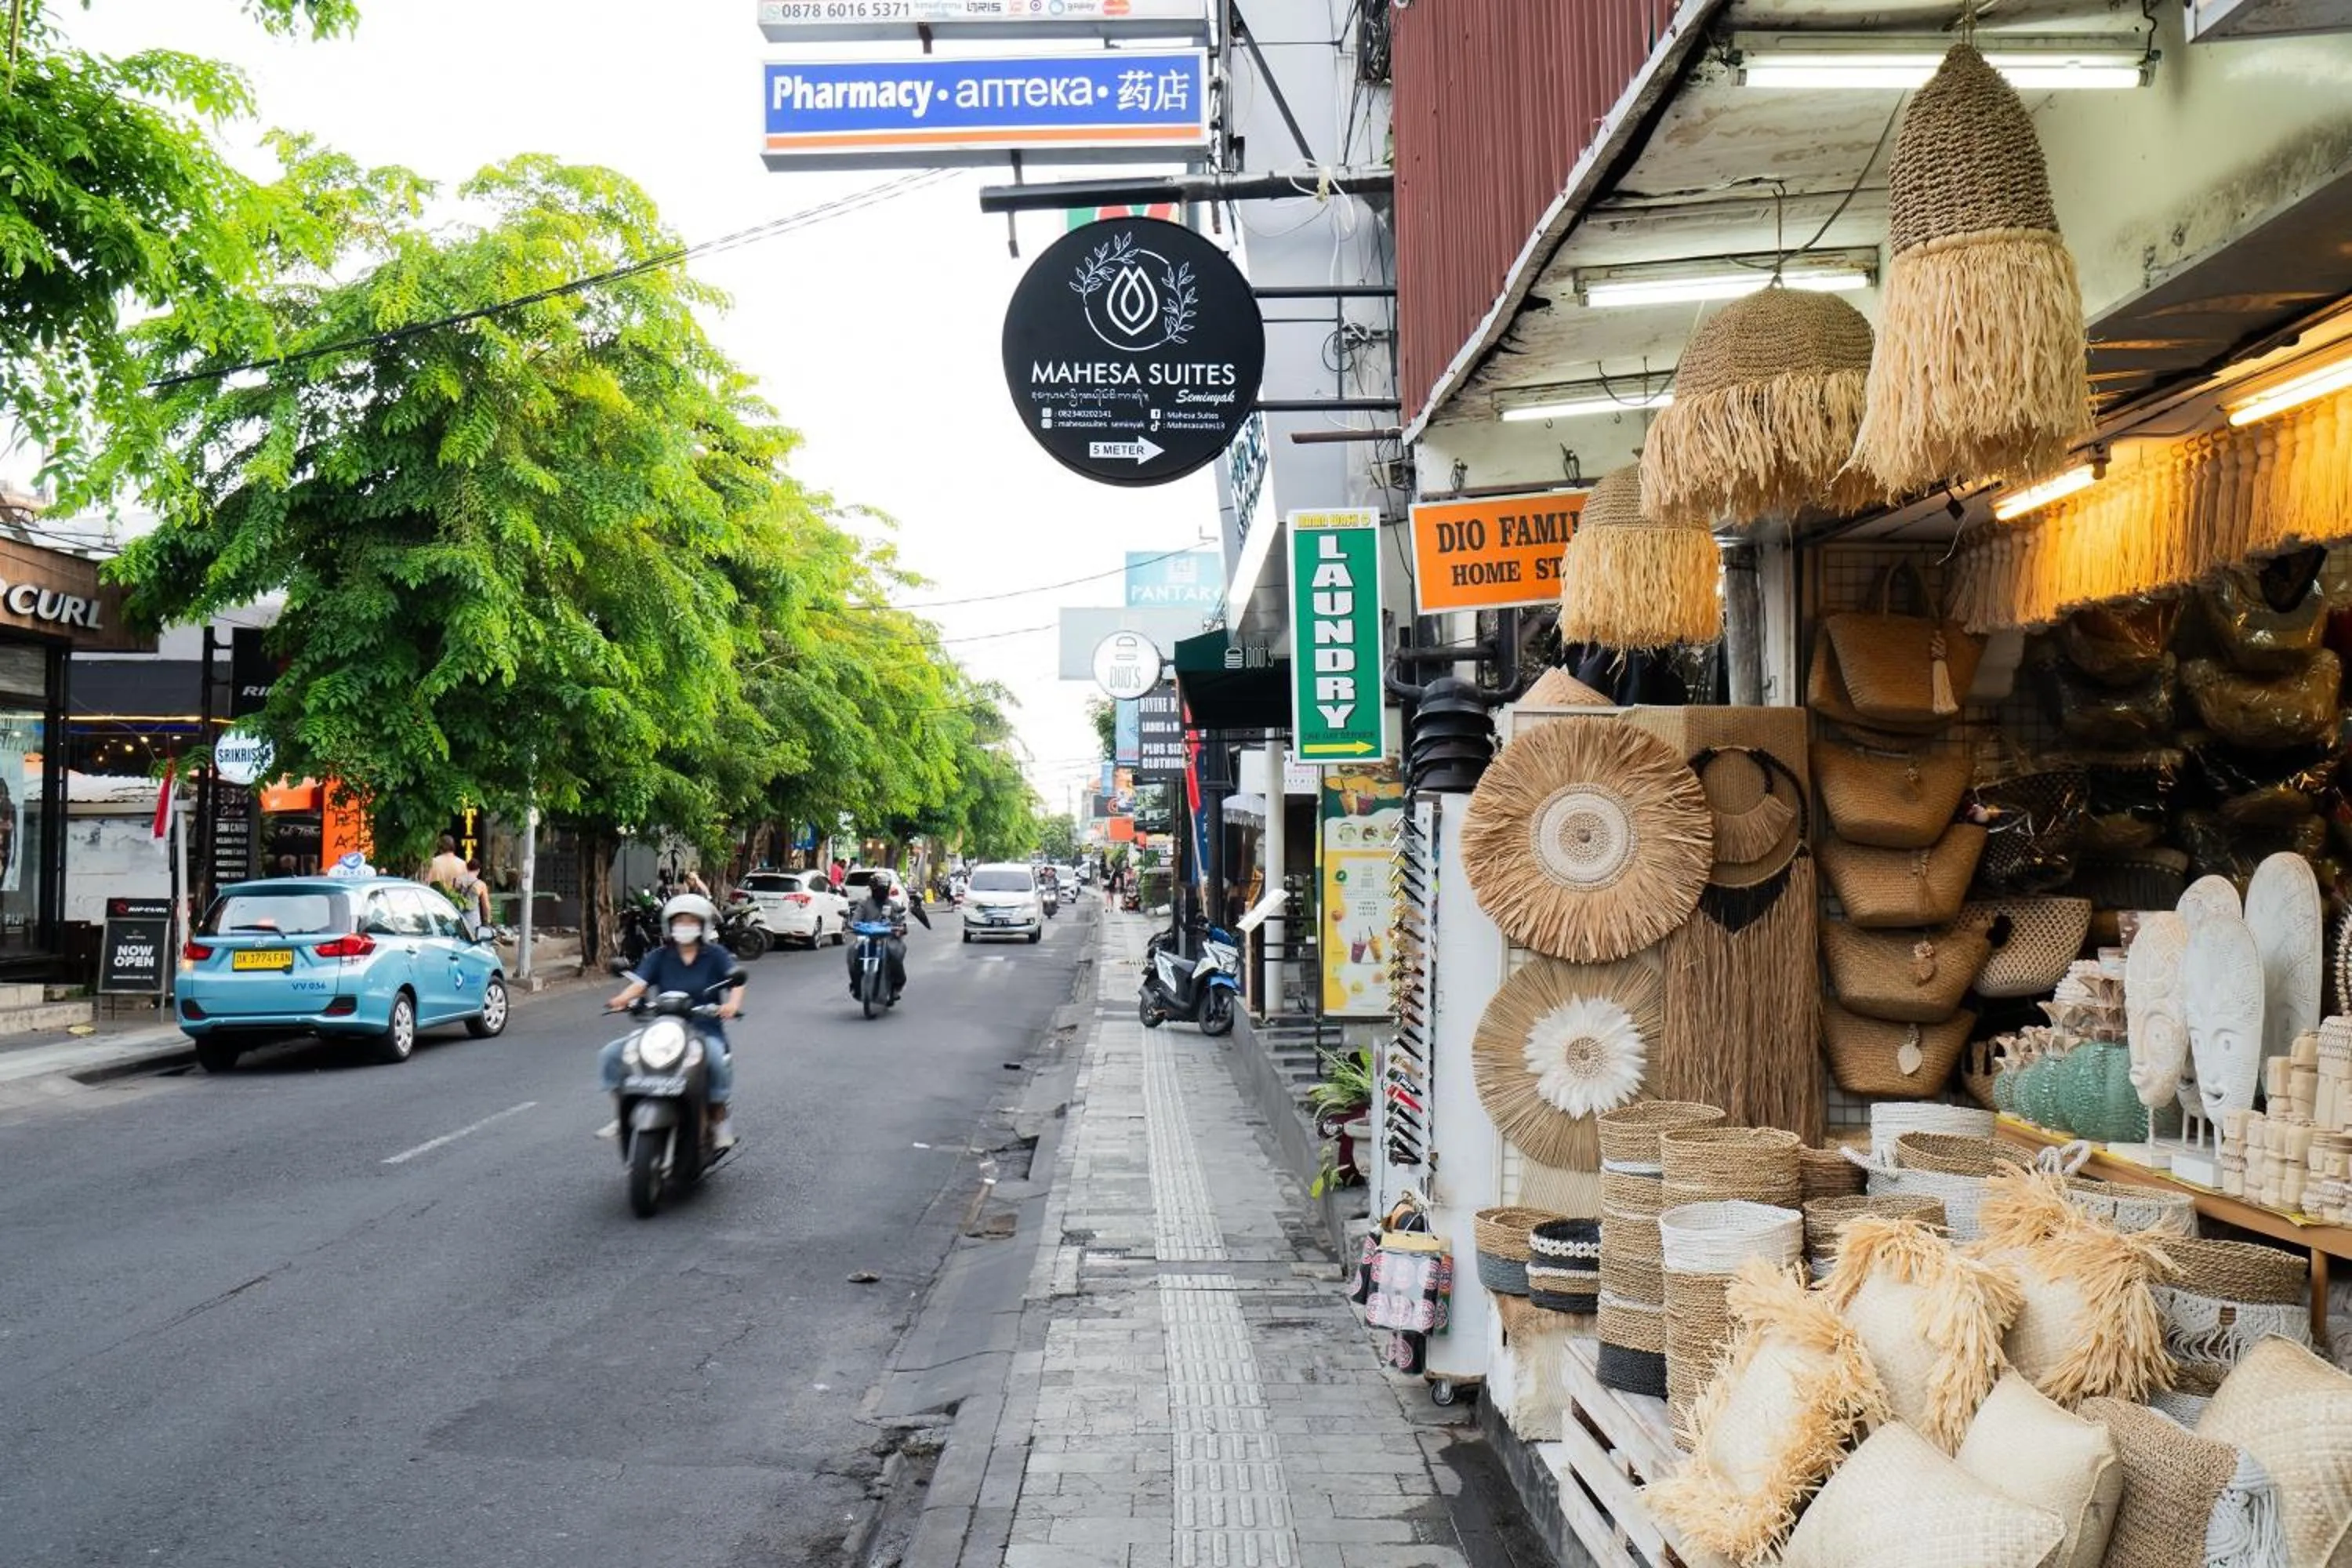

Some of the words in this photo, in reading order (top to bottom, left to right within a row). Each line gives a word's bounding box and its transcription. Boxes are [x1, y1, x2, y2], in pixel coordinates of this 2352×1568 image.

[781, 5, 822, 18] 0878
[827, 3, 866, 16] 6016
[872, 2, 909, 16] 5371
[772, 76, 934, 118] Pharmacy
[955, 75, 1094, 109] аптека
[1116, 68, 1190, 111] 药店
[1030, 361, 1142, 384] MAHESA
[1148, 363, 1236, 385] SUITES
[1175, 389, 1236, 406] Seminyak
[1093, 445, 1100, 455] 5
[1103, 445, 1145, 455] METER
[1436, 518, 1486, 554] DIO
[1451, 561, 1522, 586] HOME
[1534, 557, 1566, 580] ST
[9, 584, 104, 630] CURL
[1311, 535, 1357, 729] LAUNDRY
[242, 685, 270, 696] RI
[1142, 742, 1166, 755] PLUS
[1167, 742, 1182, 755] SIZ
[114, 956, 154, 967] OPEN
[116, 945, 154, 956] NOW
